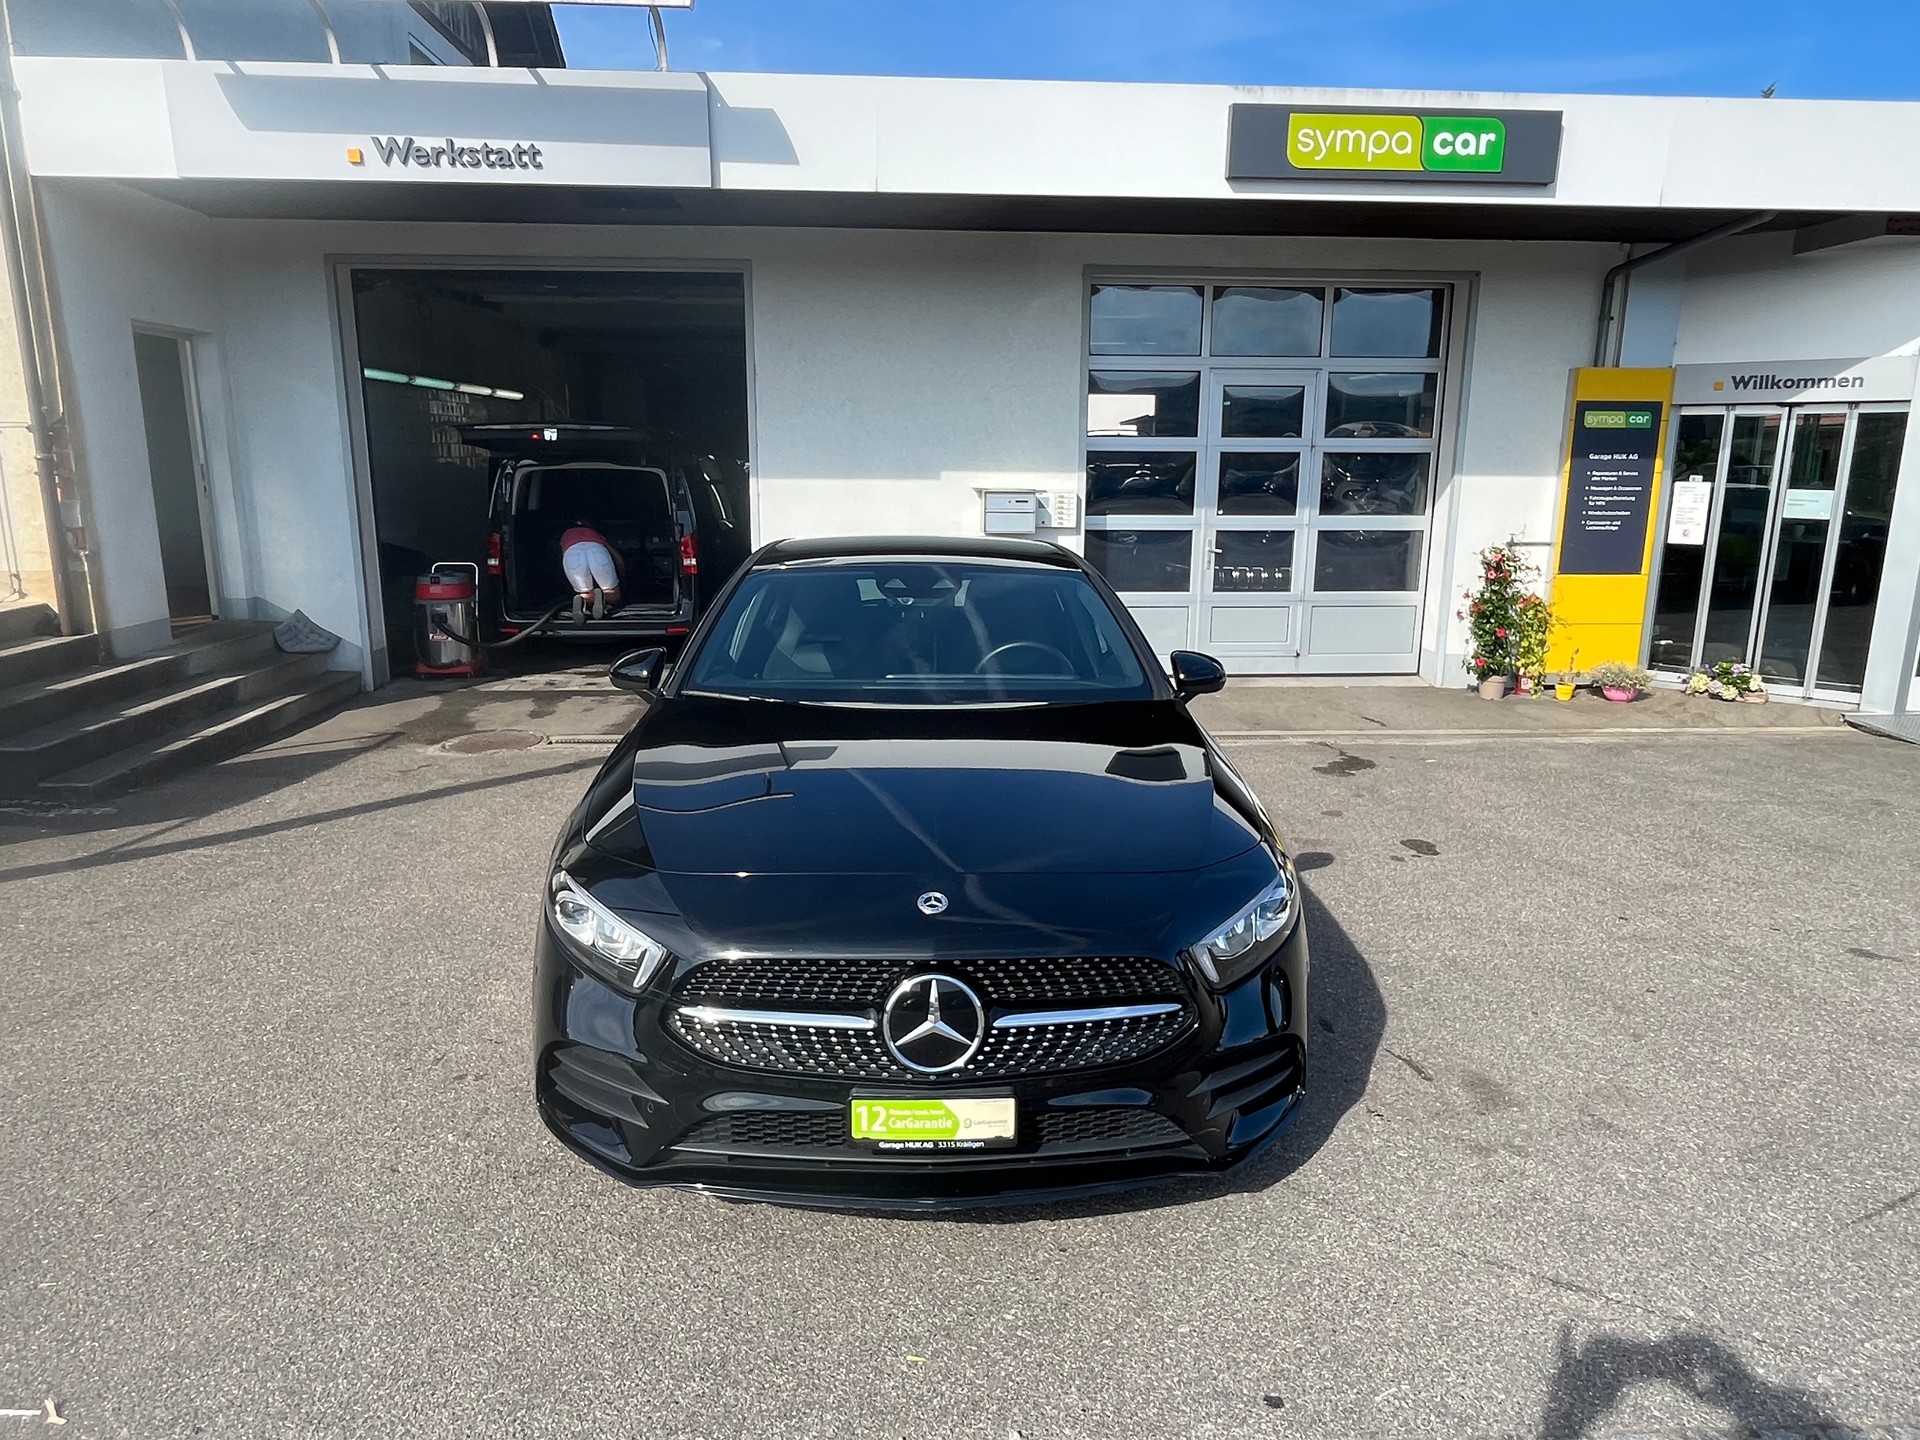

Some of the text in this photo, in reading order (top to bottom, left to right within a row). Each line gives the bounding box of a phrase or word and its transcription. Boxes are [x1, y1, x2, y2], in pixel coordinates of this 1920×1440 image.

[1296, 126, 1496, 163] sympa car
[370, 136, 544, 171] Werkstatt
[1731, 374, 1864, 391] Willkommen
[1586, 413, 1649, 425] sympa car
[1588, 453, 1612, 461] Garage
[855, 1105, 888, 1133] 12
[878, 1141, 904, 1150] Garage
[905, 1141, 922, 1149] HUK
[922, 1141, 934, 1149] AG
[937, 1140, 955, 1149] 3315
